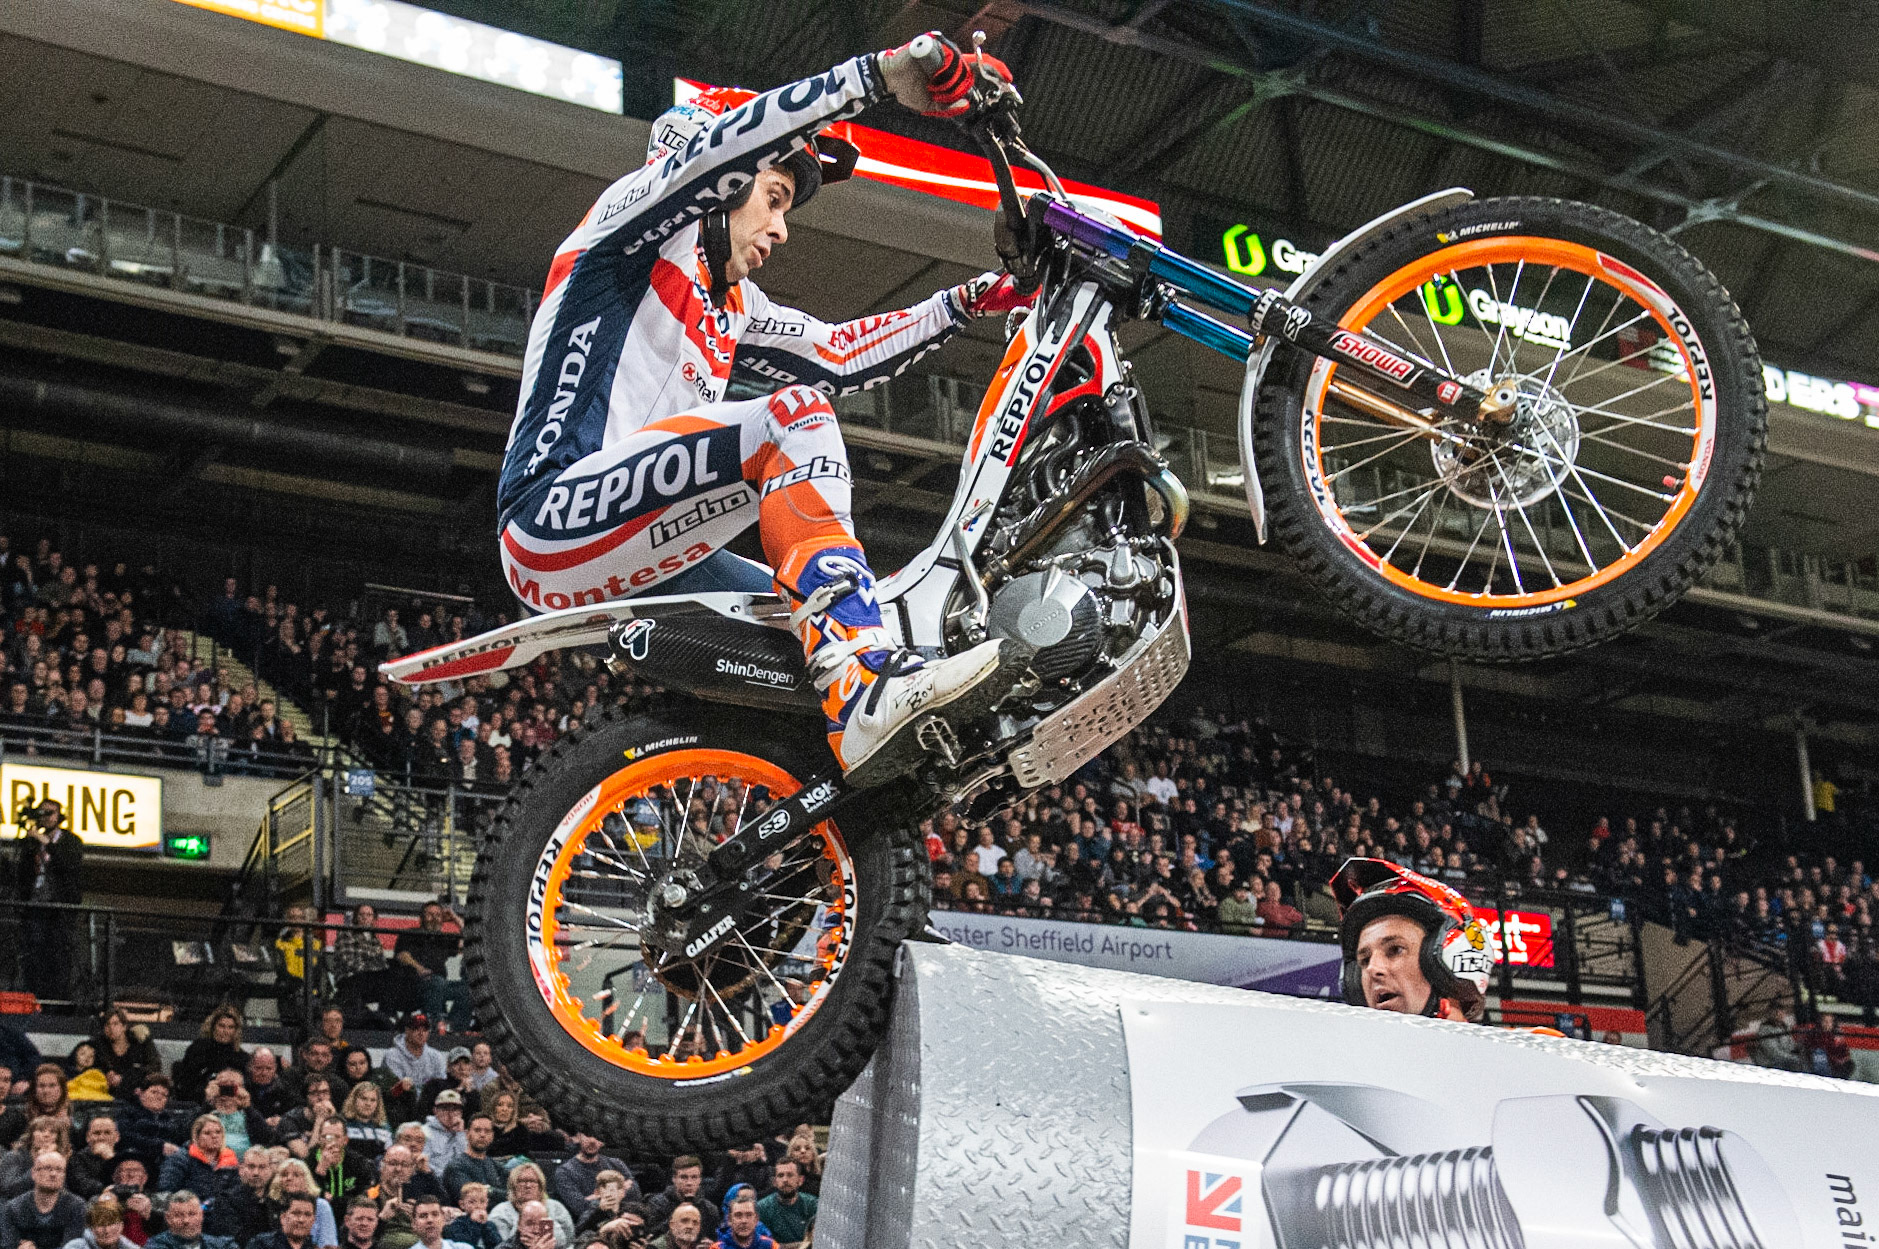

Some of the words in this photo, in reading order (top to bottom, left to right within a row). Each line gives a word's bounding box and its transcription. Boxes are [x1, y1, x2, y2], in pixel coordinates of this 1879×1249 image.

[1460, 222, 1521, 237] MICHELIN
[747, 317, 804, 337] ebo
[1335, 334, 1414, 380] SHOWA
[990, 353, 1056, 462] REPSOL
[535, 437, 719, 530] REPSOL
[650, 489, 751, 550] hebo
[509, 541, 713, 611] Montesa
[716, 658, 794, 684] ShinDengen
[645, 735, 698, 752] MICHELIN
[800, 780, 838, 809] NGK
[527, 838, 563, 948] REPSOL
[686, 915, 736, 958] GALFER
[1001, 925, 1095, 954] Sheffield
[1101, 935, 1174, 962] Airport
[1825, 1173, 1876, 1249] mai
